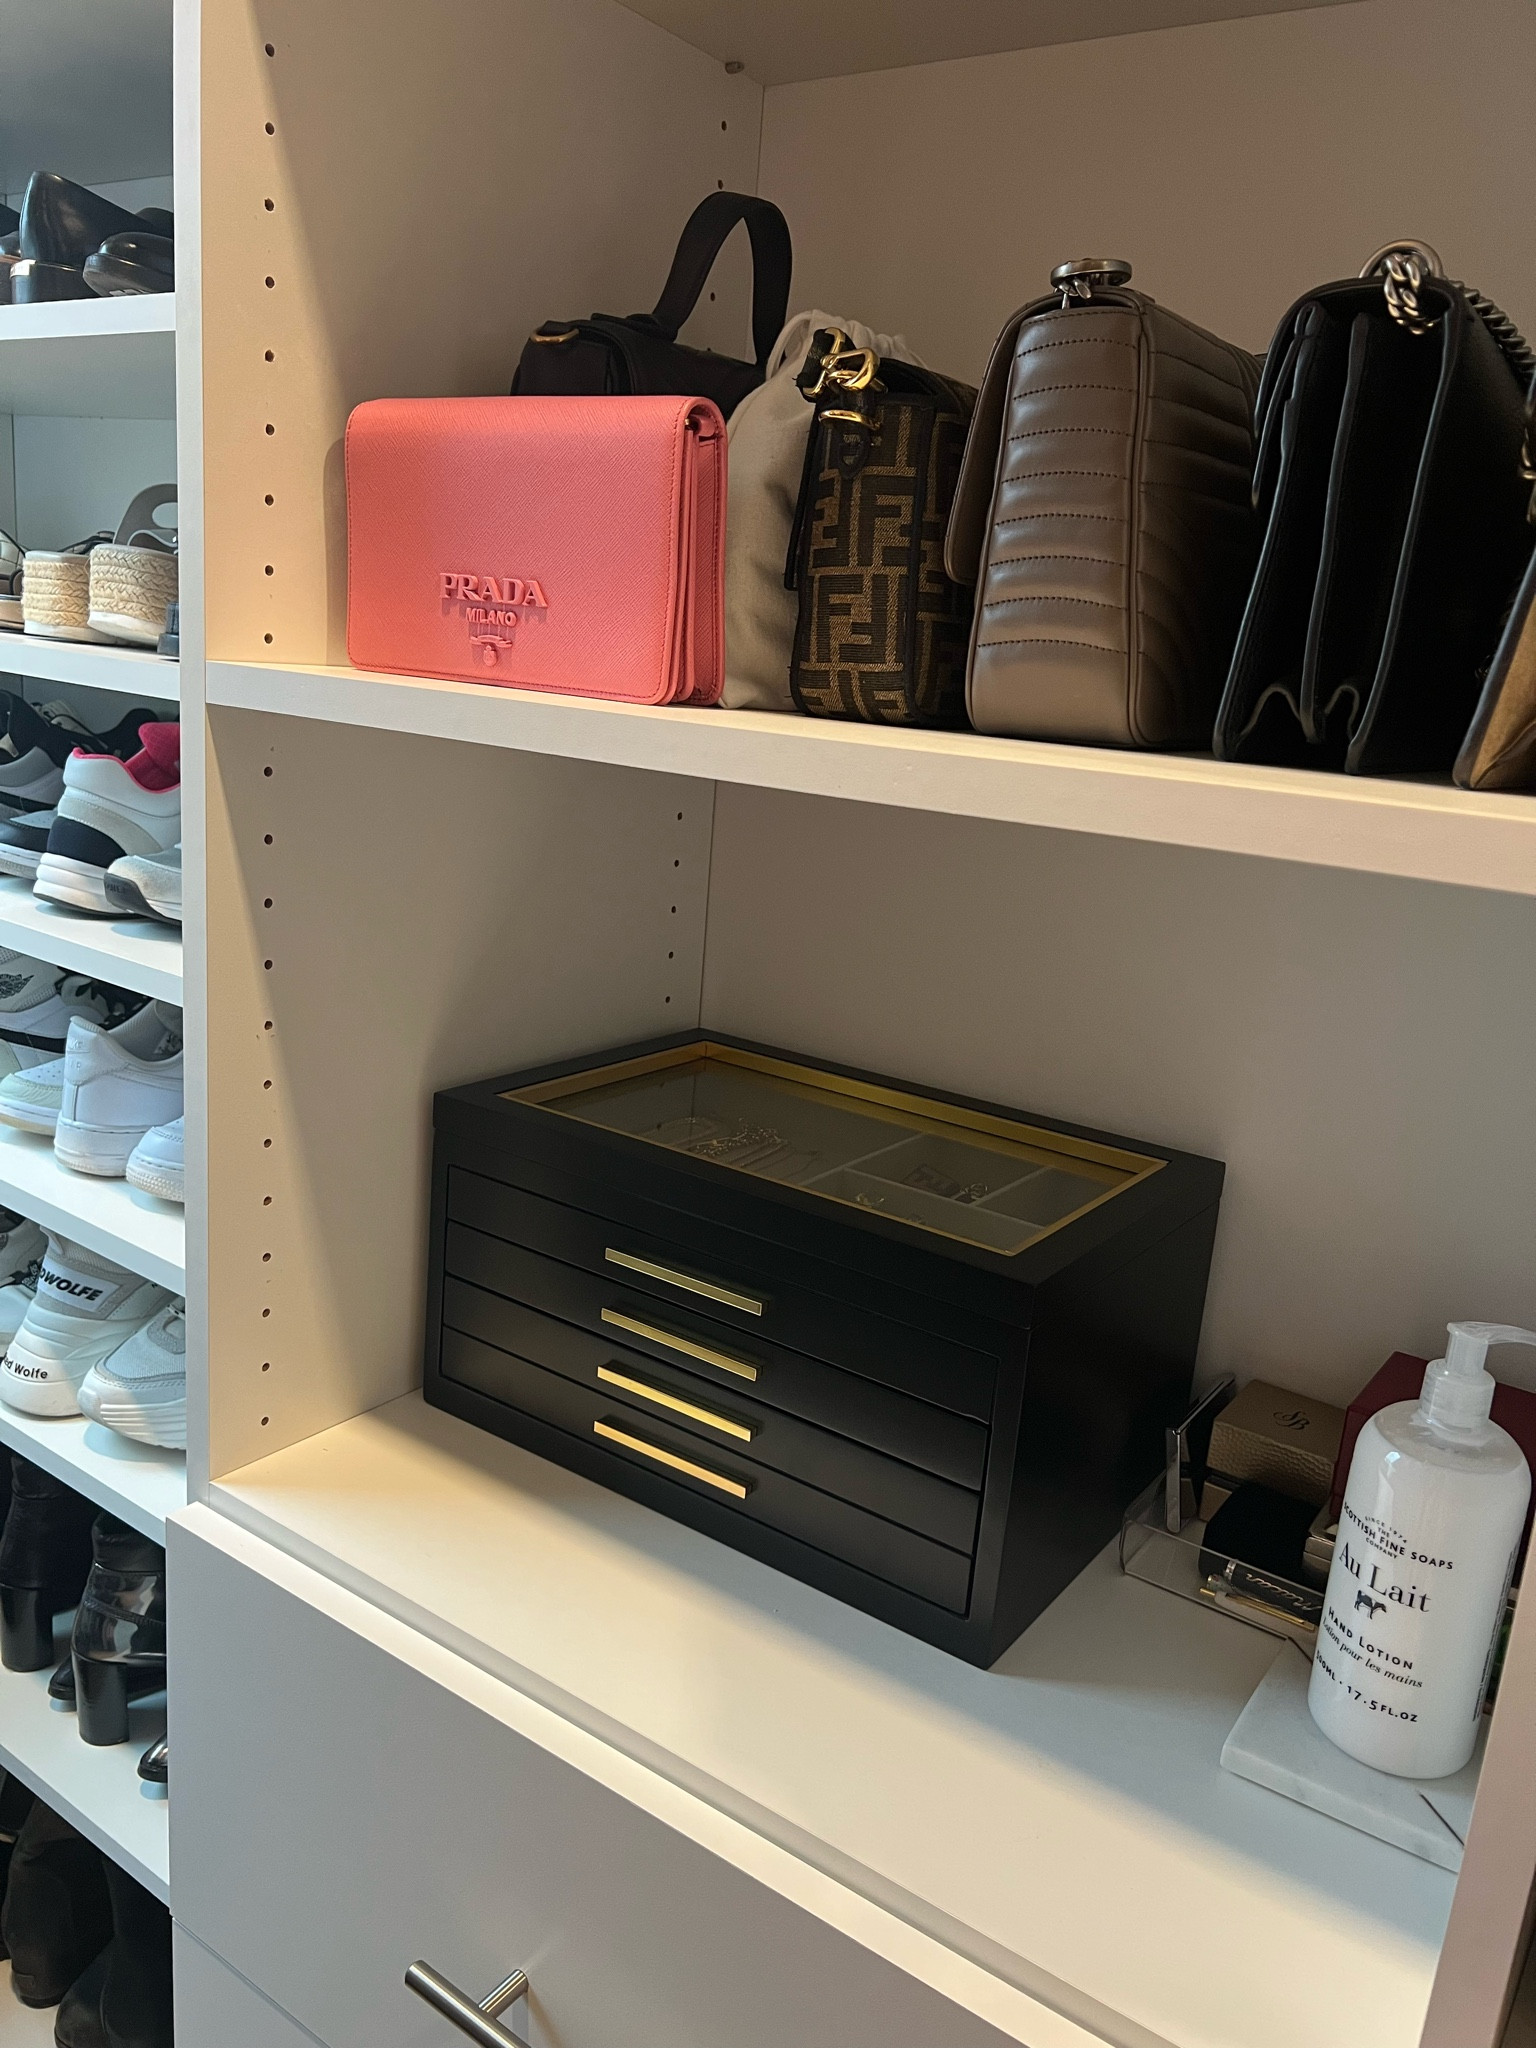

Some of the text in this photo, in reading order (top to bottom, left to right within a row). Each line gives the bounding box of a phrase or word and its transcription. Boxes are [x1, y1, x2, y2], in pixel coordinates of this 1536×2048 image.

[440, 572, 549, 608] PRADA
[465, 607, 518, 627] MILANO
[14, 1362, 48, 1379] Wolfe
[1344, 1501, 1454, 1570] SCOTTISH FINE SOAPS
[1365, 1537, 1398, 1560] COMPANY
[1378, 1527, 1390, 1538] THE
[1339, 1542, 1361, 1580] Au
[1367, 1562, 1432, 1613] Lait
[1328, 1605, 1413, 1670] HAND LOTION
[1339, 1643, 1363, 1662] pour
[1365, 1657, 1382, 1673] les
[1383, 1669, 1423, 1688] mains
